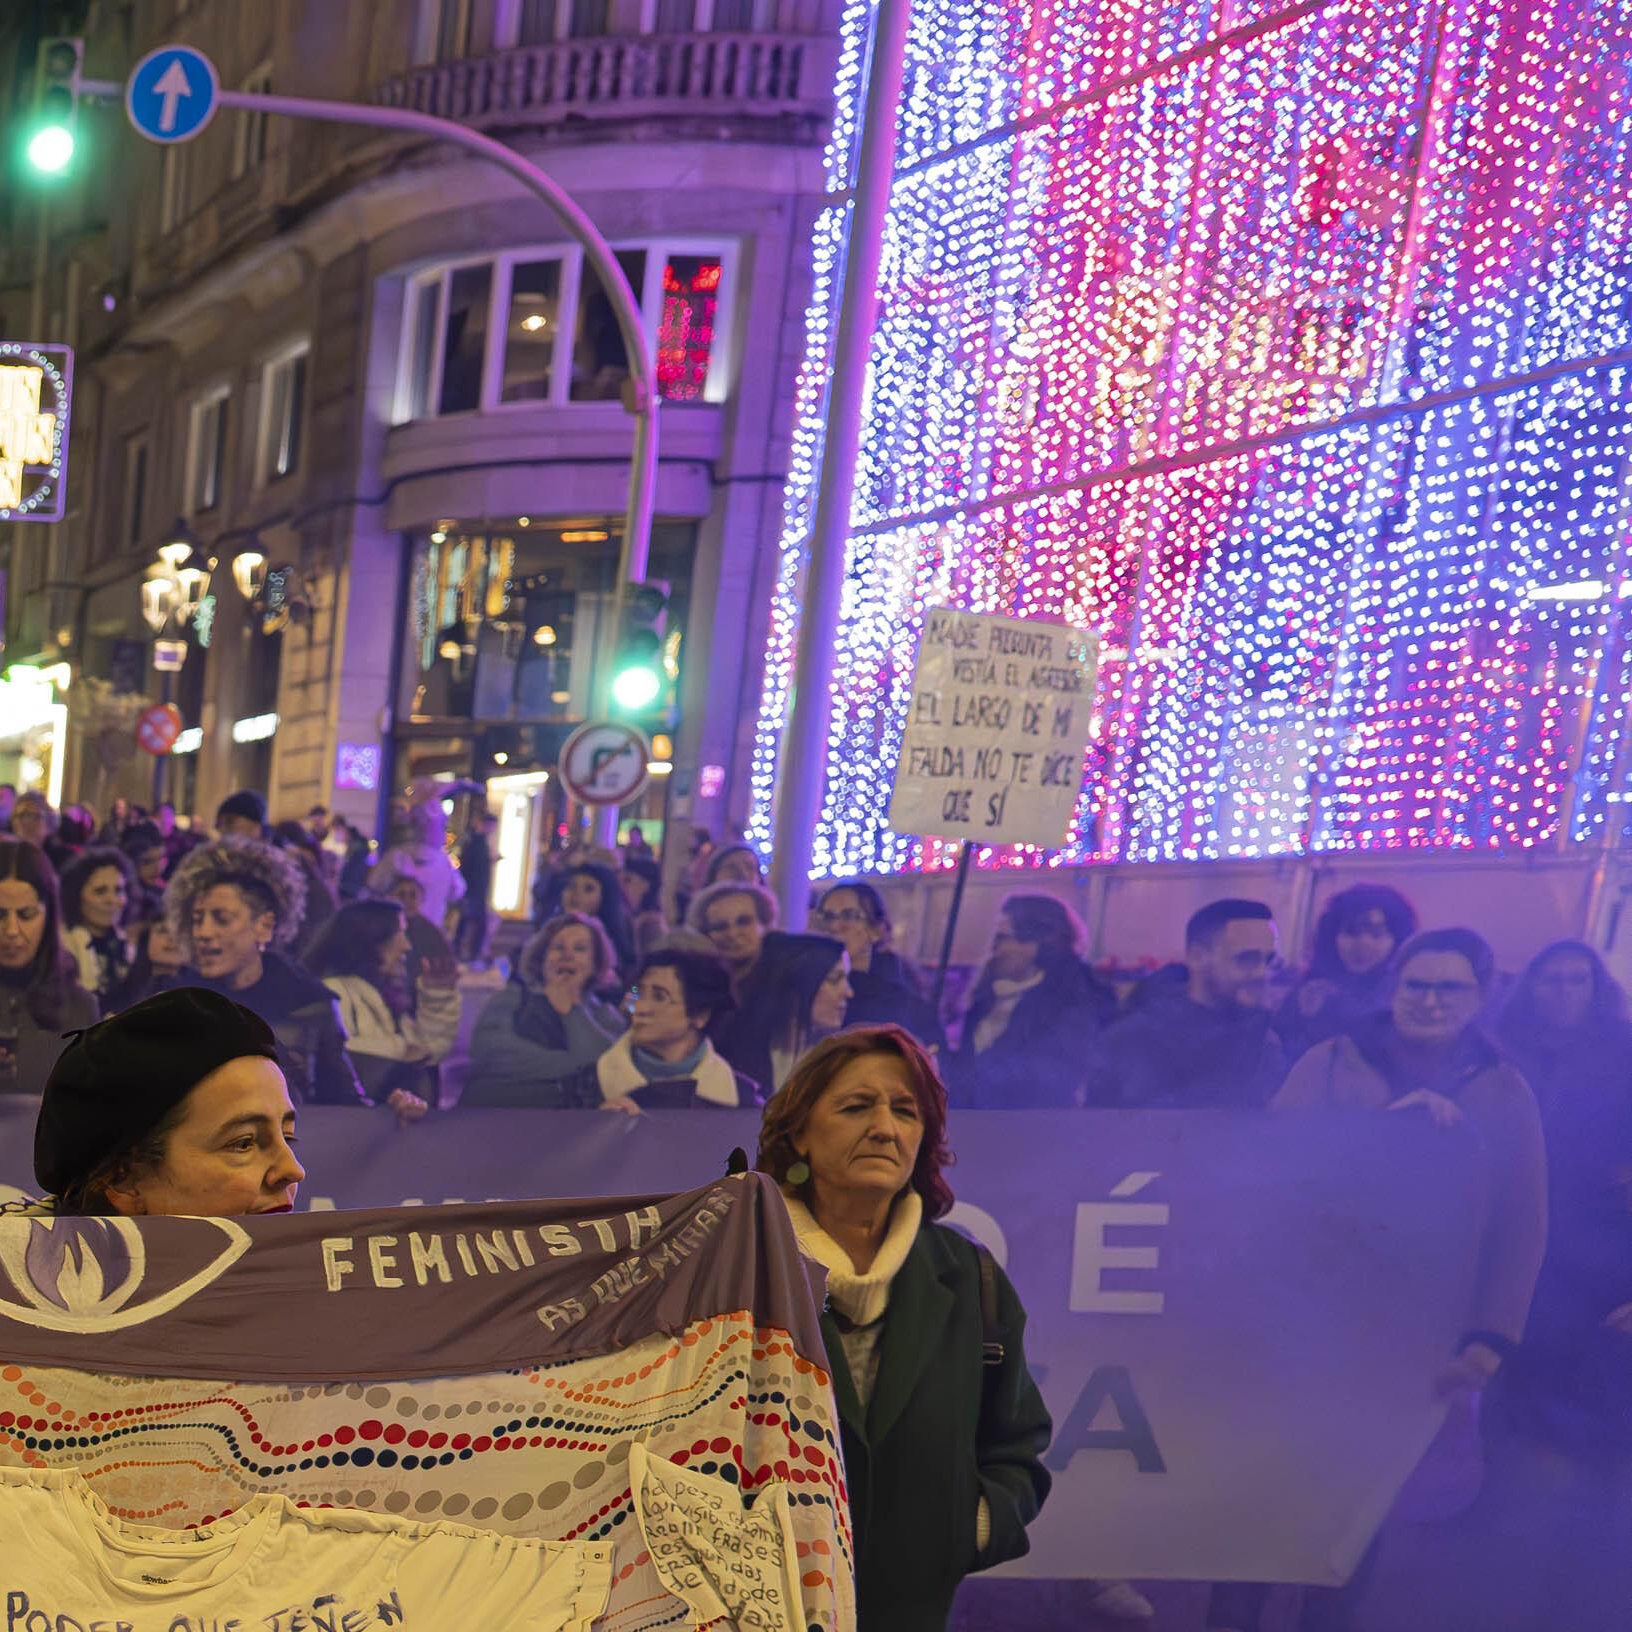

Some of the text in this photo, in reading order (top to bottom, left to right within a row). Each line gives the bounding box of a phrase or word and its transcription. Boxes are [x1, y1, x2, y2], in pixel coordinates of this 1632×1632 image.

[915, 692, 941, 725] EL
[952, 695, 1011, 730] LARGO
[1022, 702, 1043, 735] DE
[908, 747, 964, 777] FALDA
[973, 747, 1003, 780] NO
[1009, 752, 1033, 785] TE
[942, 789, 973, 823] QUE
